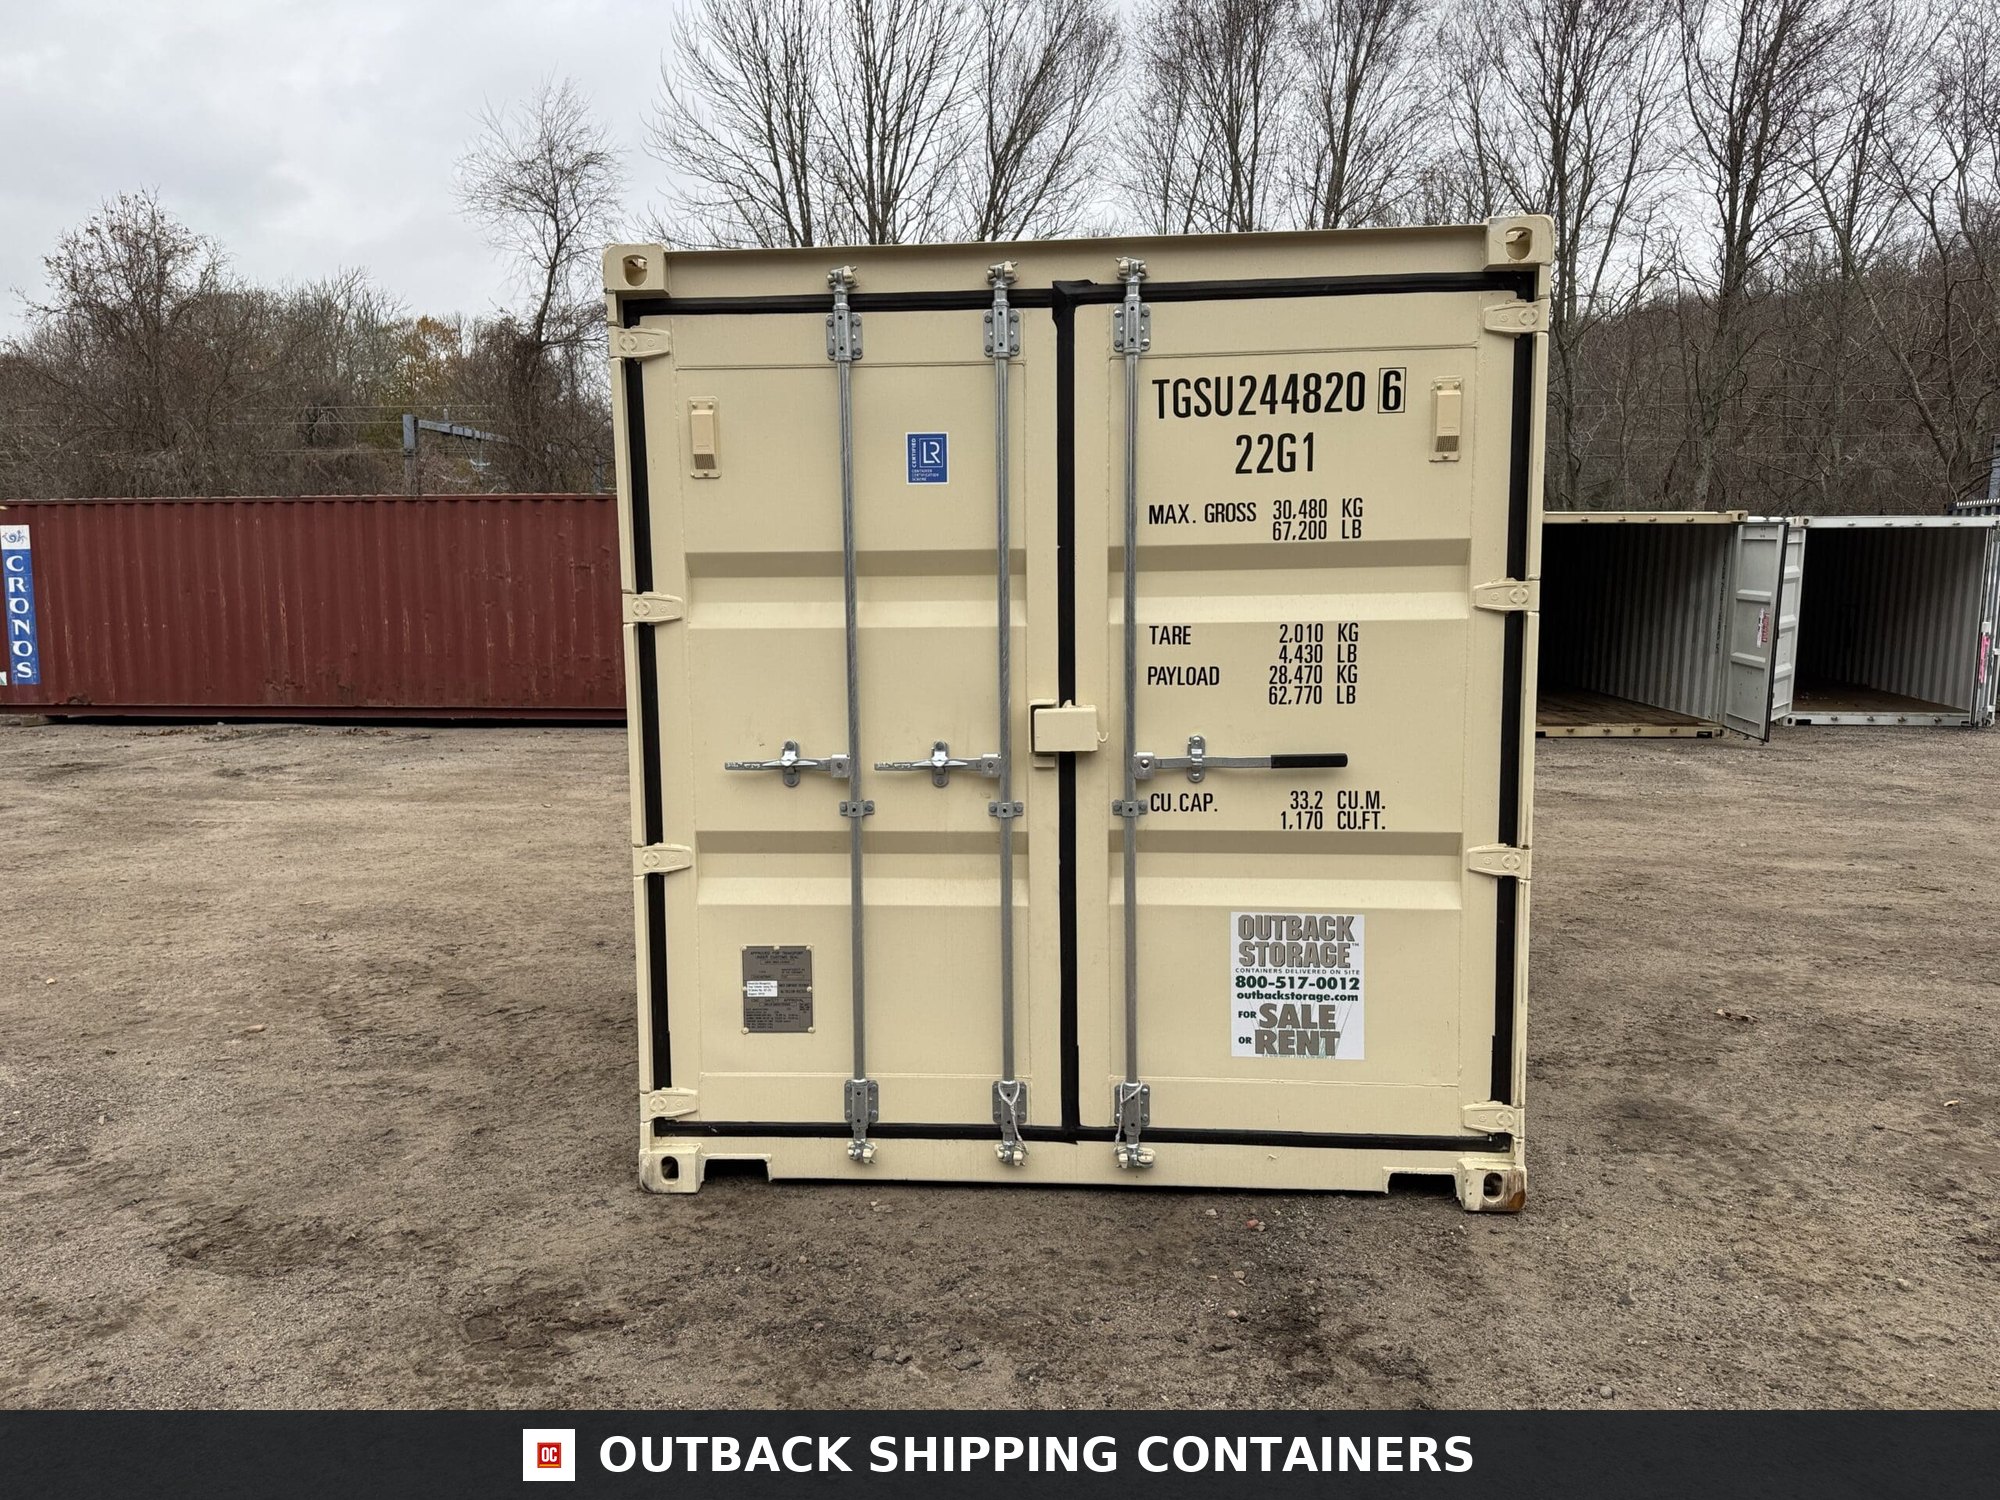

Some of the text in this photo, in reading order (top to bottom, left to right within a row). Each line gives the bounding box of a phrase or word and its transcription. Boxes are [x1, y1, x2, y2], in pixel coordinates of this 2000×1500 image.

[1383, 371, 1401, 410] 6
[923, 442, 941, 464] LR
[1236, 432, 1313, 474] 22G1
[1149, 498, 1362, 524] MAX. GROSS 30,480 KG
[1273, 519, 1361, 540] 67,200 LB
[6, 555, 33, 678] CRONOS
[1149, 623, 1358, 644] TARE 2,010 KG
[1279, 644, 1356, 663] 4,430 LB
[1148, 665, 1357, 685] PAYLOAD 28,470 KG
[1269, 685, 1355, 704] 62,770 LB
[1151, 791, 1385, 811] CU.CAP. 33.2 CU.M.
[1281, 811, 1385, 829] 1,170 CU.FT.
[1238, 914, 1355, 942] OUTBACK
[1238, 941, 1351, 969] STORAGE
[1235, 976, 1360, 990] 800-517-0012
[1237, 990, 1358, 1002] outbackstorage.com
[1238, 1003, 1336, 1030] FOR SALE
[1238, 1030, 1341, 1056] OR RENT
